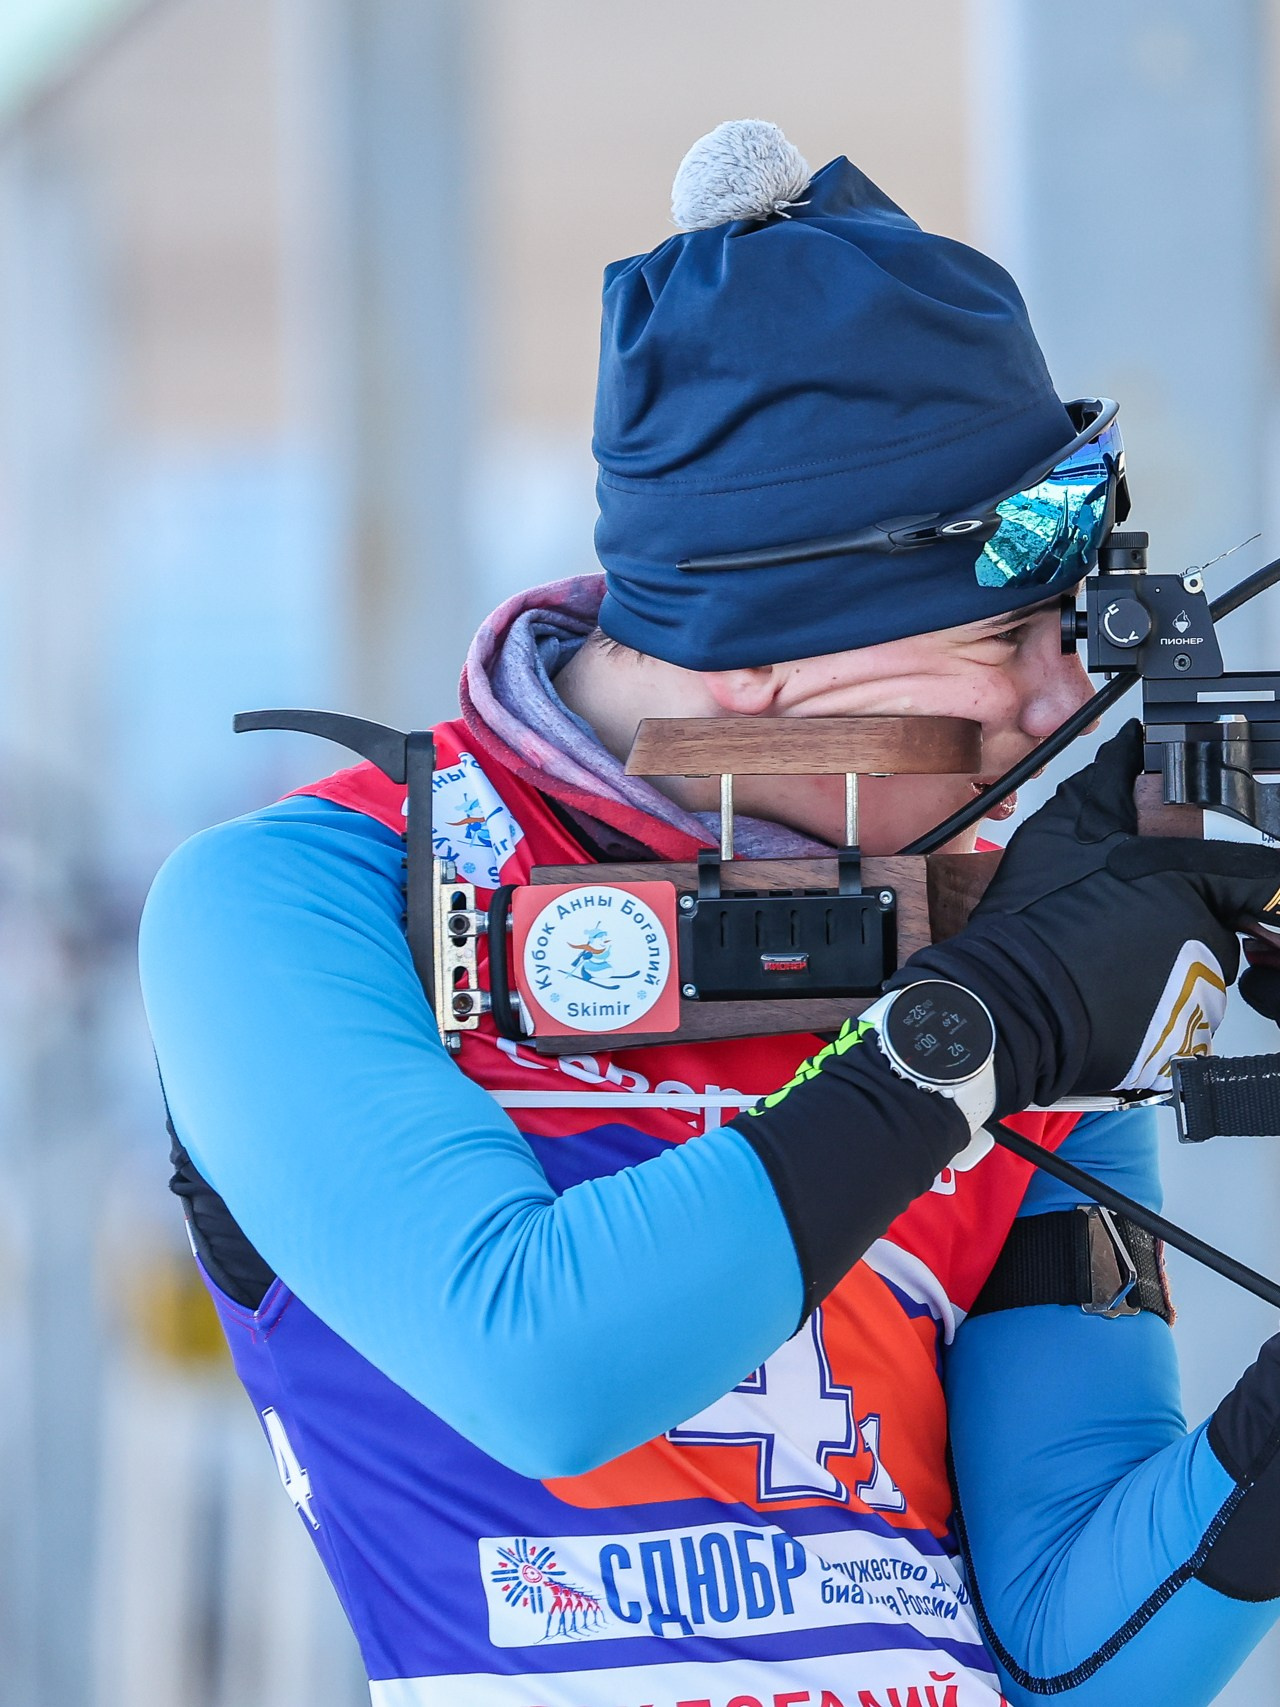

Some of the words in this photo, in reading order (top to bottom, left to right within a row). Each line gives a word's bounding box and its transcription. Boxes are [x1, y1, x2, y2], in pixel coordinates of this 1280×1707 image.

[1160, 637, 1204, 646] ПИОНЕР
[532, 922, 556, 990] Кубок
[556, 895, 613, 920] Анны
[620, 899, 661, 986] Богалий
[567, 1001, 631, 1017] Skimir
[665, 1306, 856, 1504] 4
[855, 1413, 907, 1515] 1
[261, 1405, 320, 1531] 4
[600, 1530, 807, 1636] СДЮБР
[896, 1587, 958, 1620] России
